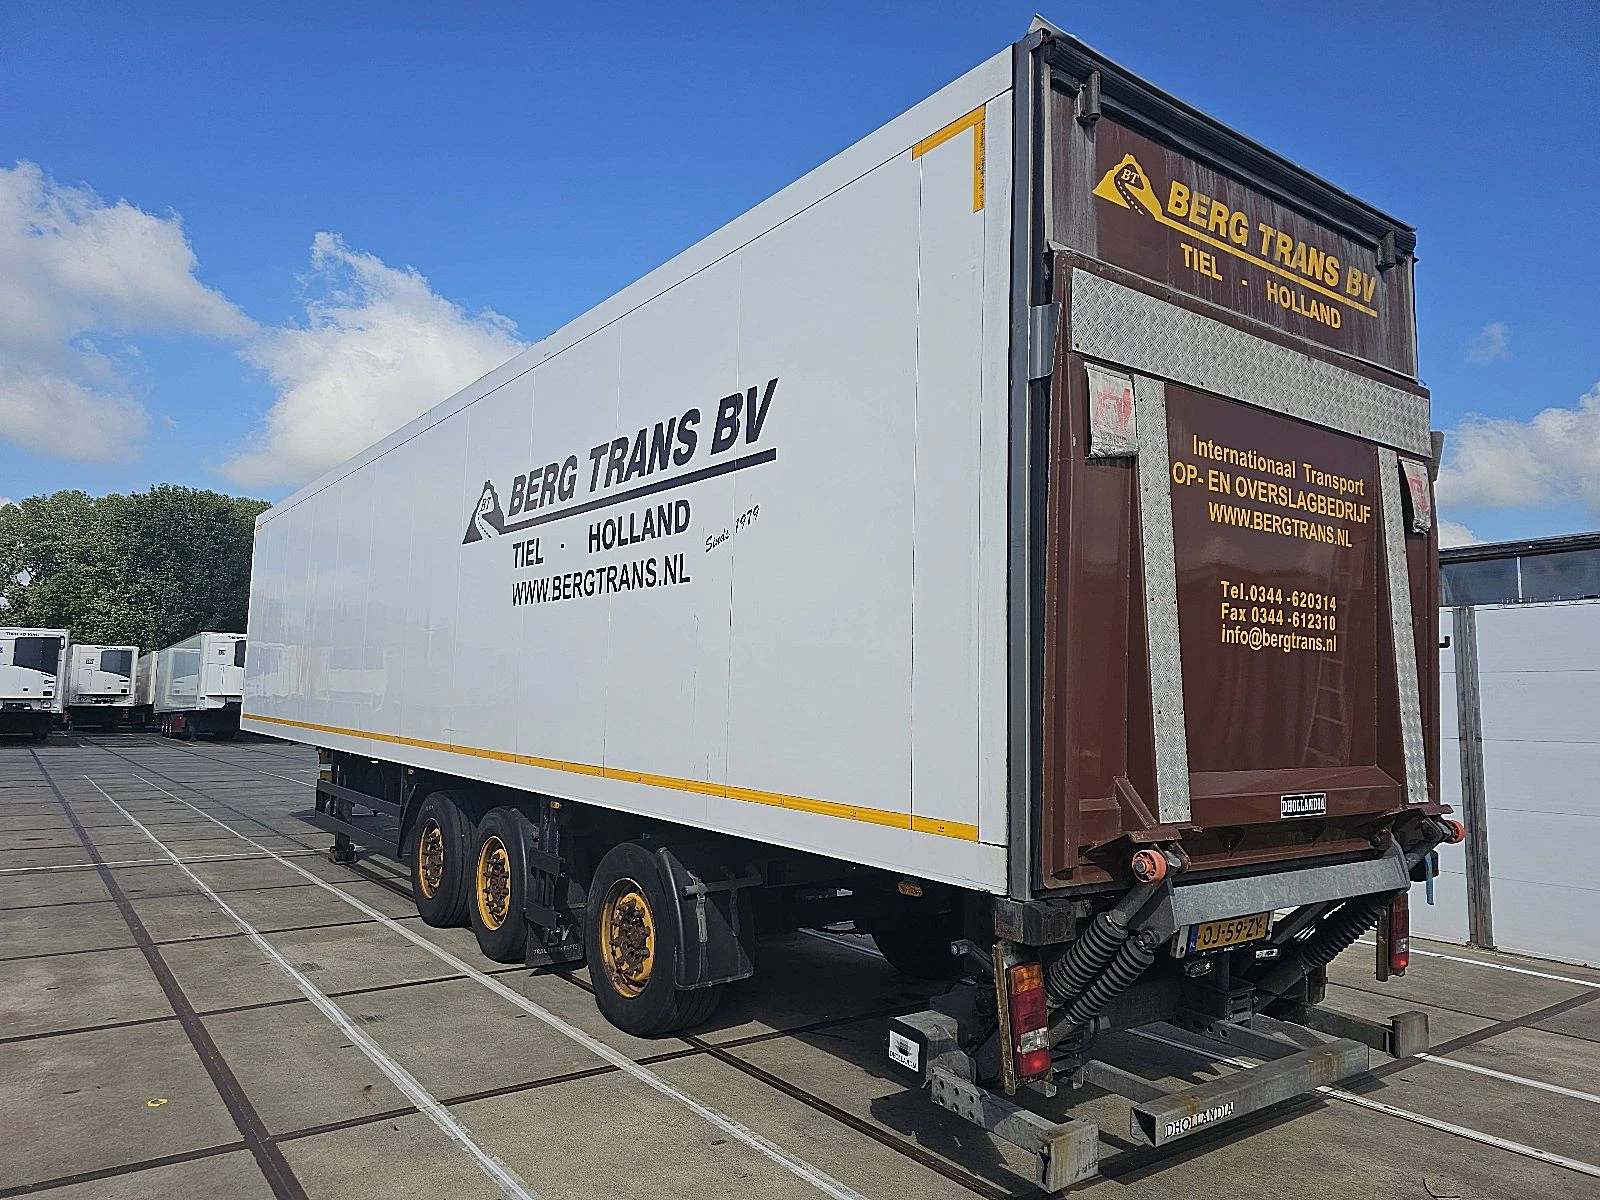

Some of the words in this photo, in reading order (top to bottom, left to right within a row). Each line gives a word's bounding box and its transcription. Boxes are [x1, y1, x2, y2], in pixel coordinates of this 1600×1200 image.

[1121, 169, 1140, 184] BT
[1167, 180, 1248, 246] BERG
[1258, 222, 1340, 287] TRANS
[1345, 265, 1377, 302] BV
[1180, 242, 1223, 281] TIEL
[1266, 279, 1341, 330] HOLLAND
[508, 454, 578, 517] BERG
[589, 408, 700, 492] TRANS
[710, 377, 779, 455] BV
[1193, 434, 1296, 479] Internationaal
[1303, 463, 1365, 496] Transport
[1172, 461, 1204, 486] OP-
[1208, 469, 1230, 494] EN
[1235, 476, 1371, 524] OVERSLAGBEDRIJF
[512, 538, 544, 569] TIEL
[588, 499, 691, 553] HOLLAND
[736, 505, 760, 533] 1979
[1208, 501, 1353, 547] WWW.BERGTRANS.NL
[512, 553, 691, 607] WWW.BERGTRANS.NL
[1221, 602, 1246, 622] Fax
[1251, 606, 1284, 626] 0344
[1221, 624, 1337, 653] info@bergtrans.nl
[1282, 797, 1325, 813] DHOLLANDIA
[1165, 1102, 1234, 1138] DHOLLANDIA
